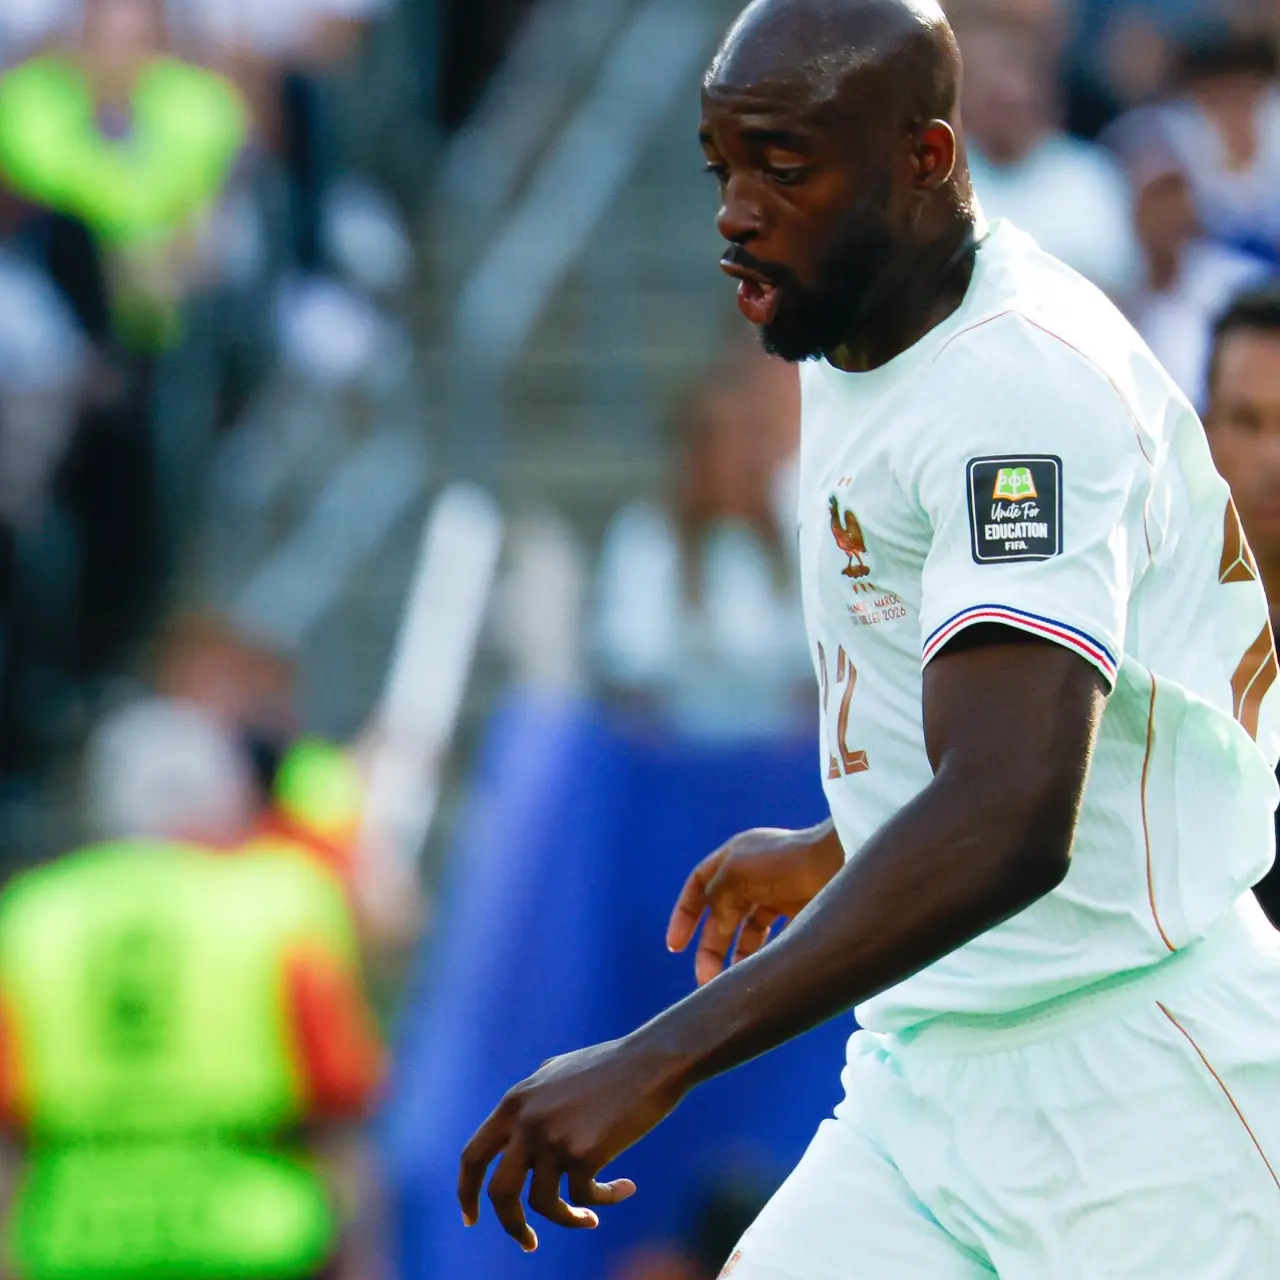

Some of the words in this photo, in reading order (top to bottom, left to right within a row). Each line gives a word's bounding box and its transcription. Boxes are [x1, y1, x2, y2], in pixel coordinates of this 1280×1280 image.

[991, 502, 1020, 521] Unite
[1021, 502, 1040, 519] For
[984, 522, 1048, 540] EDUCATION
[1005, 541, 1027, 551] FIFA
[882, 606, 907, 621] 2026
